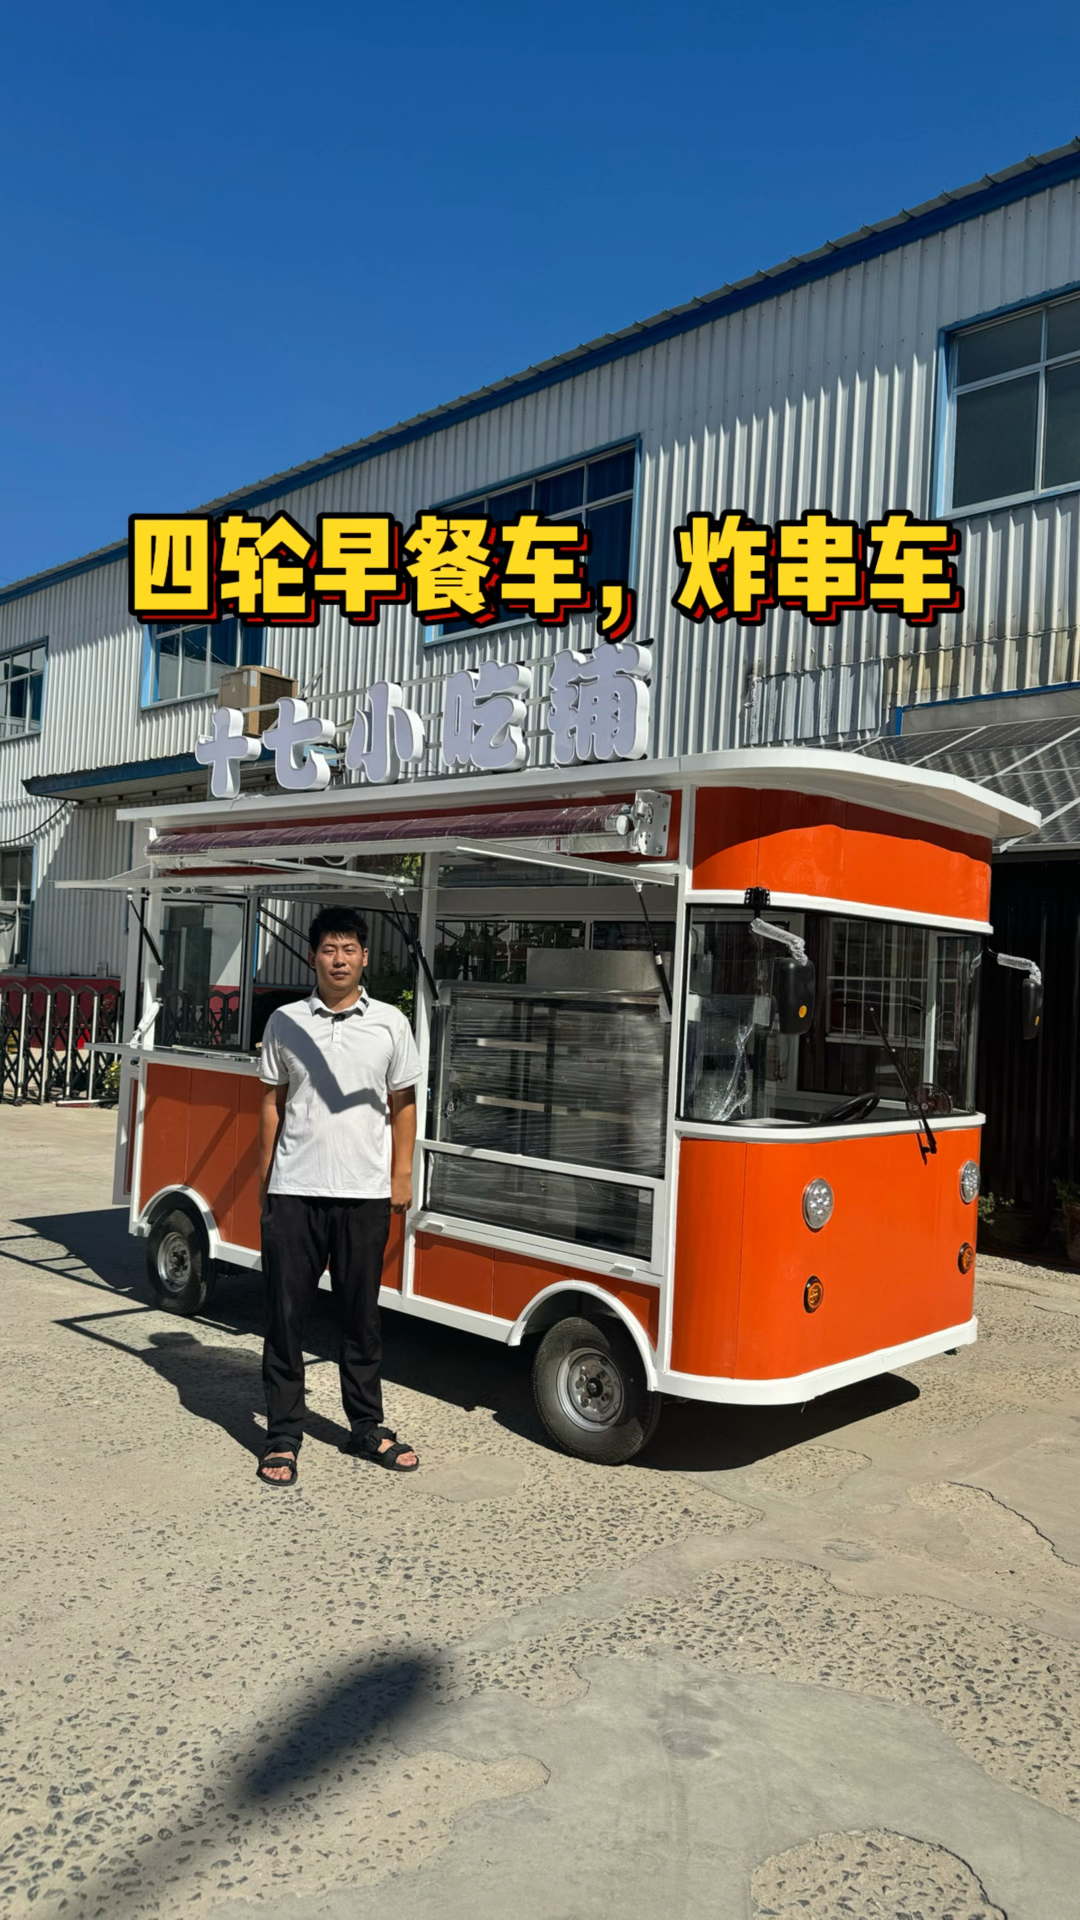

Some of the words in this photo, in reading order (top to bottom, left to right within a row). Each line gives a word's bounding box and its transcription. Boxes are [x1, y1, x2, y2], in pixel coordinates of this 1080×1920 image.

[195, 642, 652, 798] 十七小吃铺
